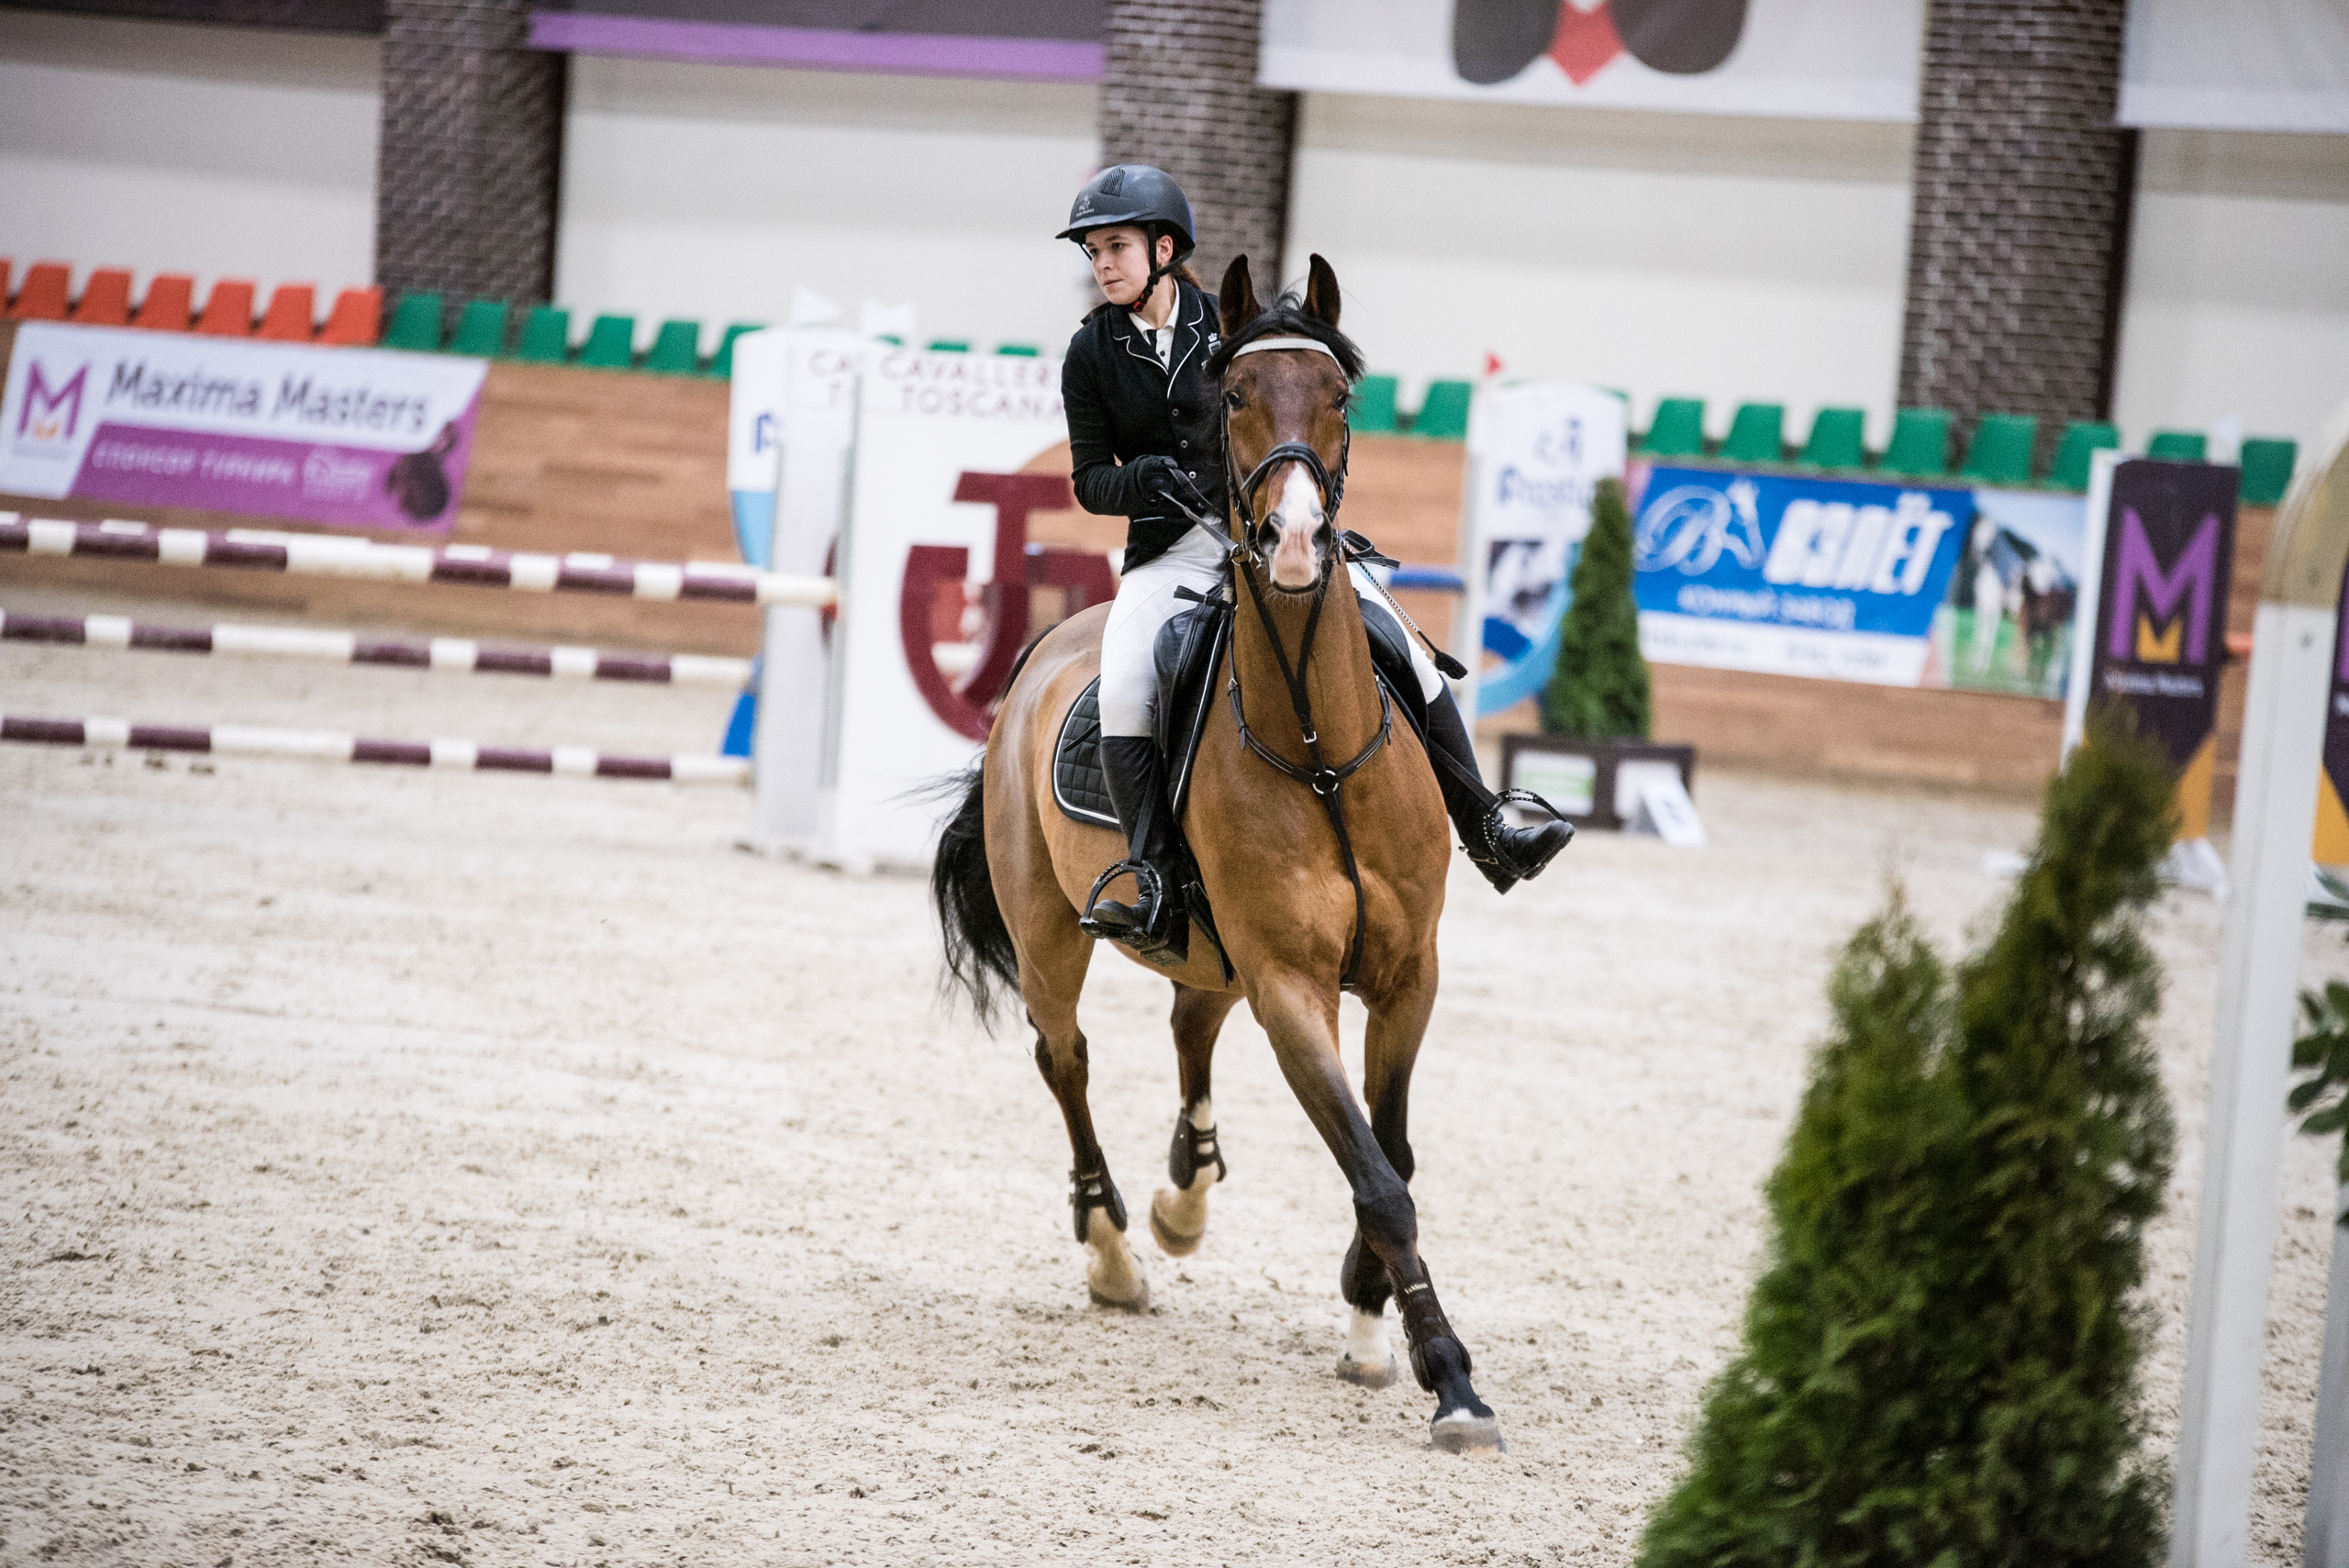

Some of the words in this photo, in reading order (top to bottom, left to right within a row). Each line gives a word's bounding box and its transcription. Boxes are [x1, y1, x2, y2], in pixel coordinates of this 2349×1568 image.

[104, 361, 262, 416] Maxima
[272, 373, 429, 433] Masters
[878, 351, 1062, 389] CAVALLER
